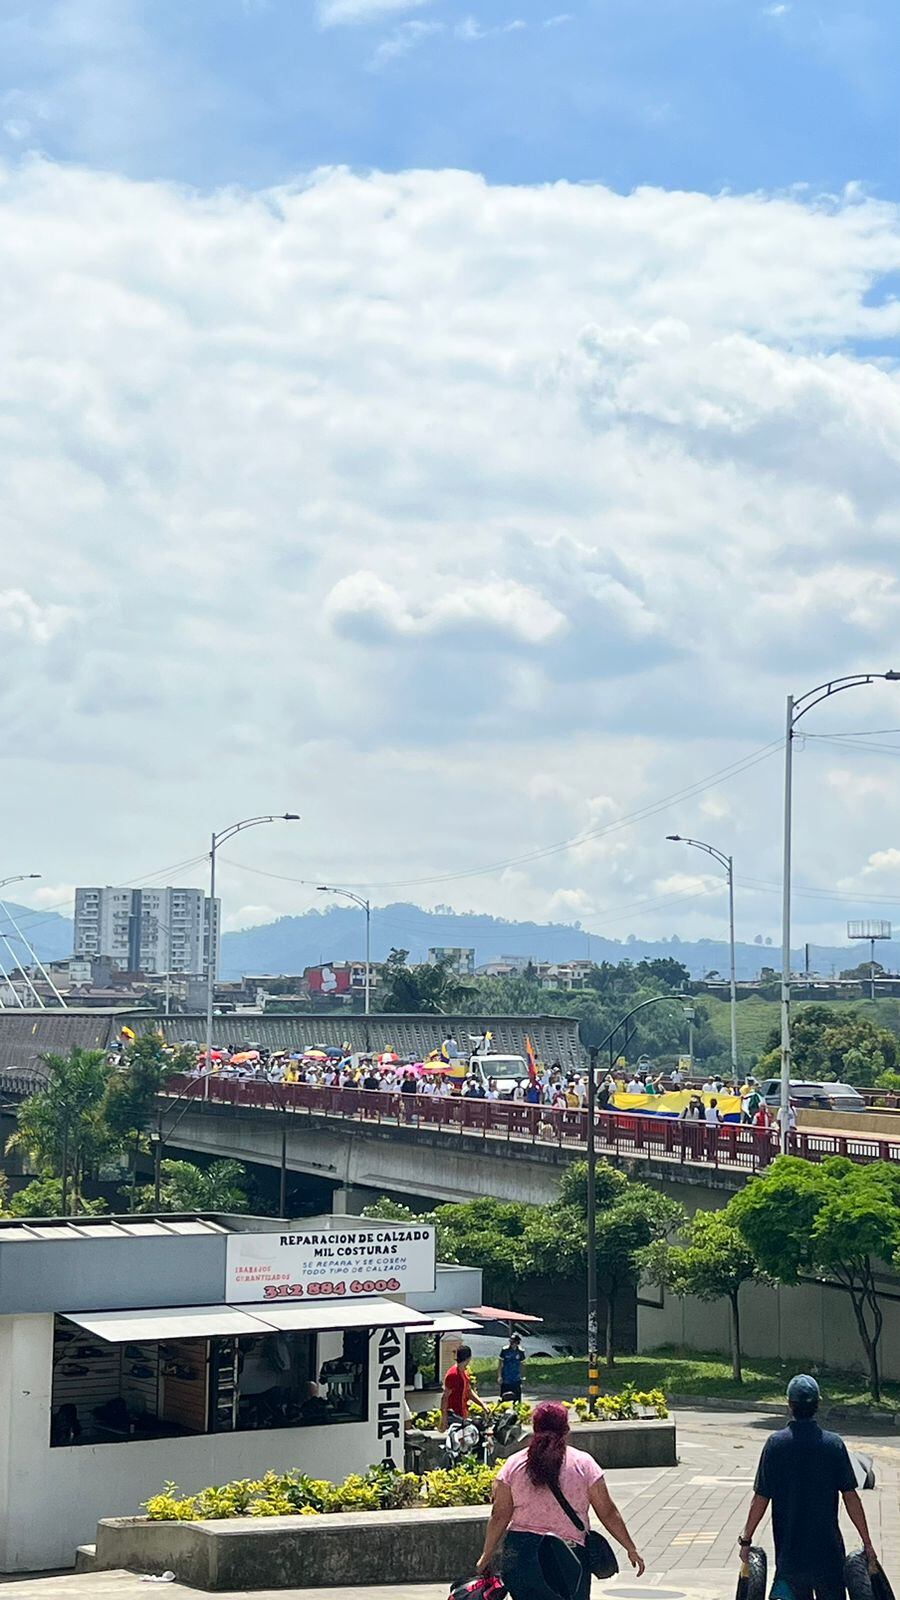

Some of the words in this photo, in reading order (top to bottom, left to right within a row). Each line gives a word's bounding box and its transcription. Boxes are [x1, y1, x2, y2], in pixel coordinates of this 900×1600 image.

[279, 1233, 357, 1246] REPARACION
[358, 1233, 374, 1243] DE
[376, 1230, 430, 1242] CALZADO
[314, 1247, 334, 1257] MIL
[336, 1244, 398, 1256] COSTURAS
[315, 1260, 353, 1268] REPARA
[365, 1264, 408, 1272] CALZADO
[263, 1284, 304, 1299] 312
[306, 1281, 346, 1296] 884
[349, 1278, 400, 1293] 6006
